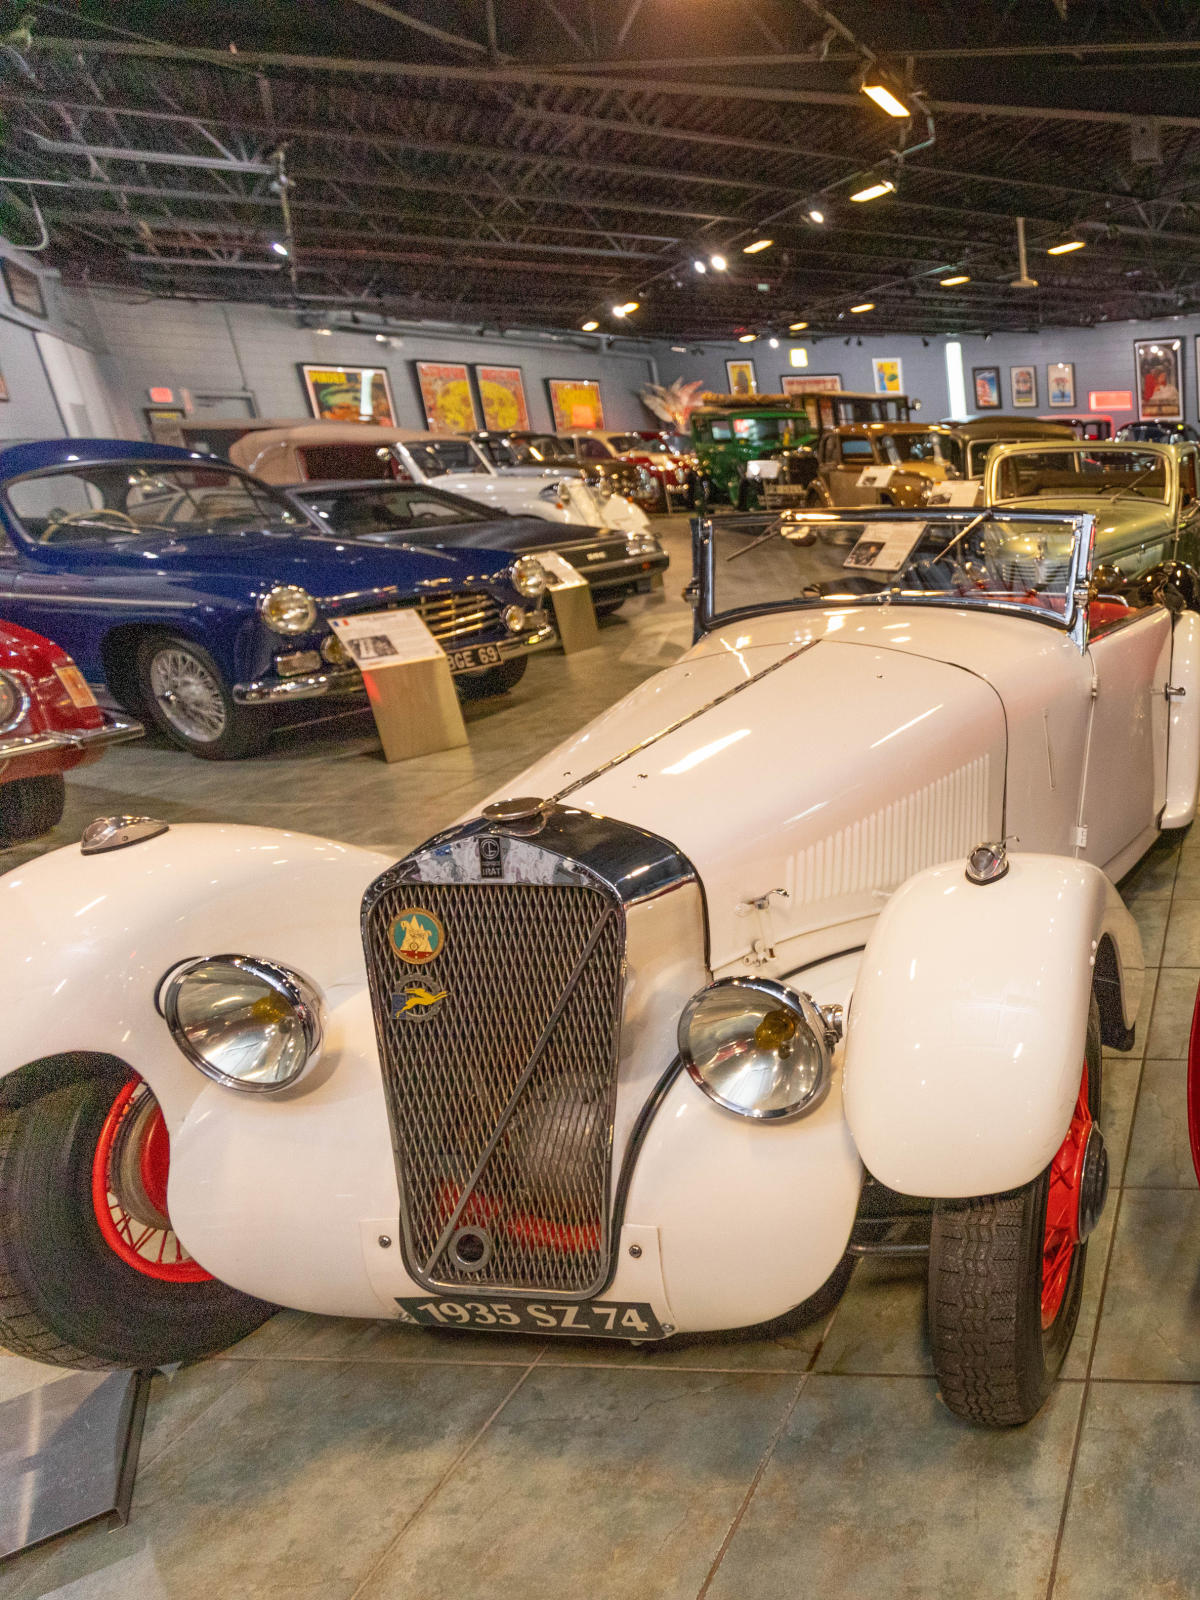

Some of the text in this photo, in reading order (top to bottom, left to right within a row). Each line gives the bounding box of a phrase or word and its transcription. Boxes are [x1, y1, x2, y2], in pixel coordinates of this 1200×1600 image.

[478, 646, 497, 664] 69
[417, 1302, 649, 1332] 1935 SZ 74
